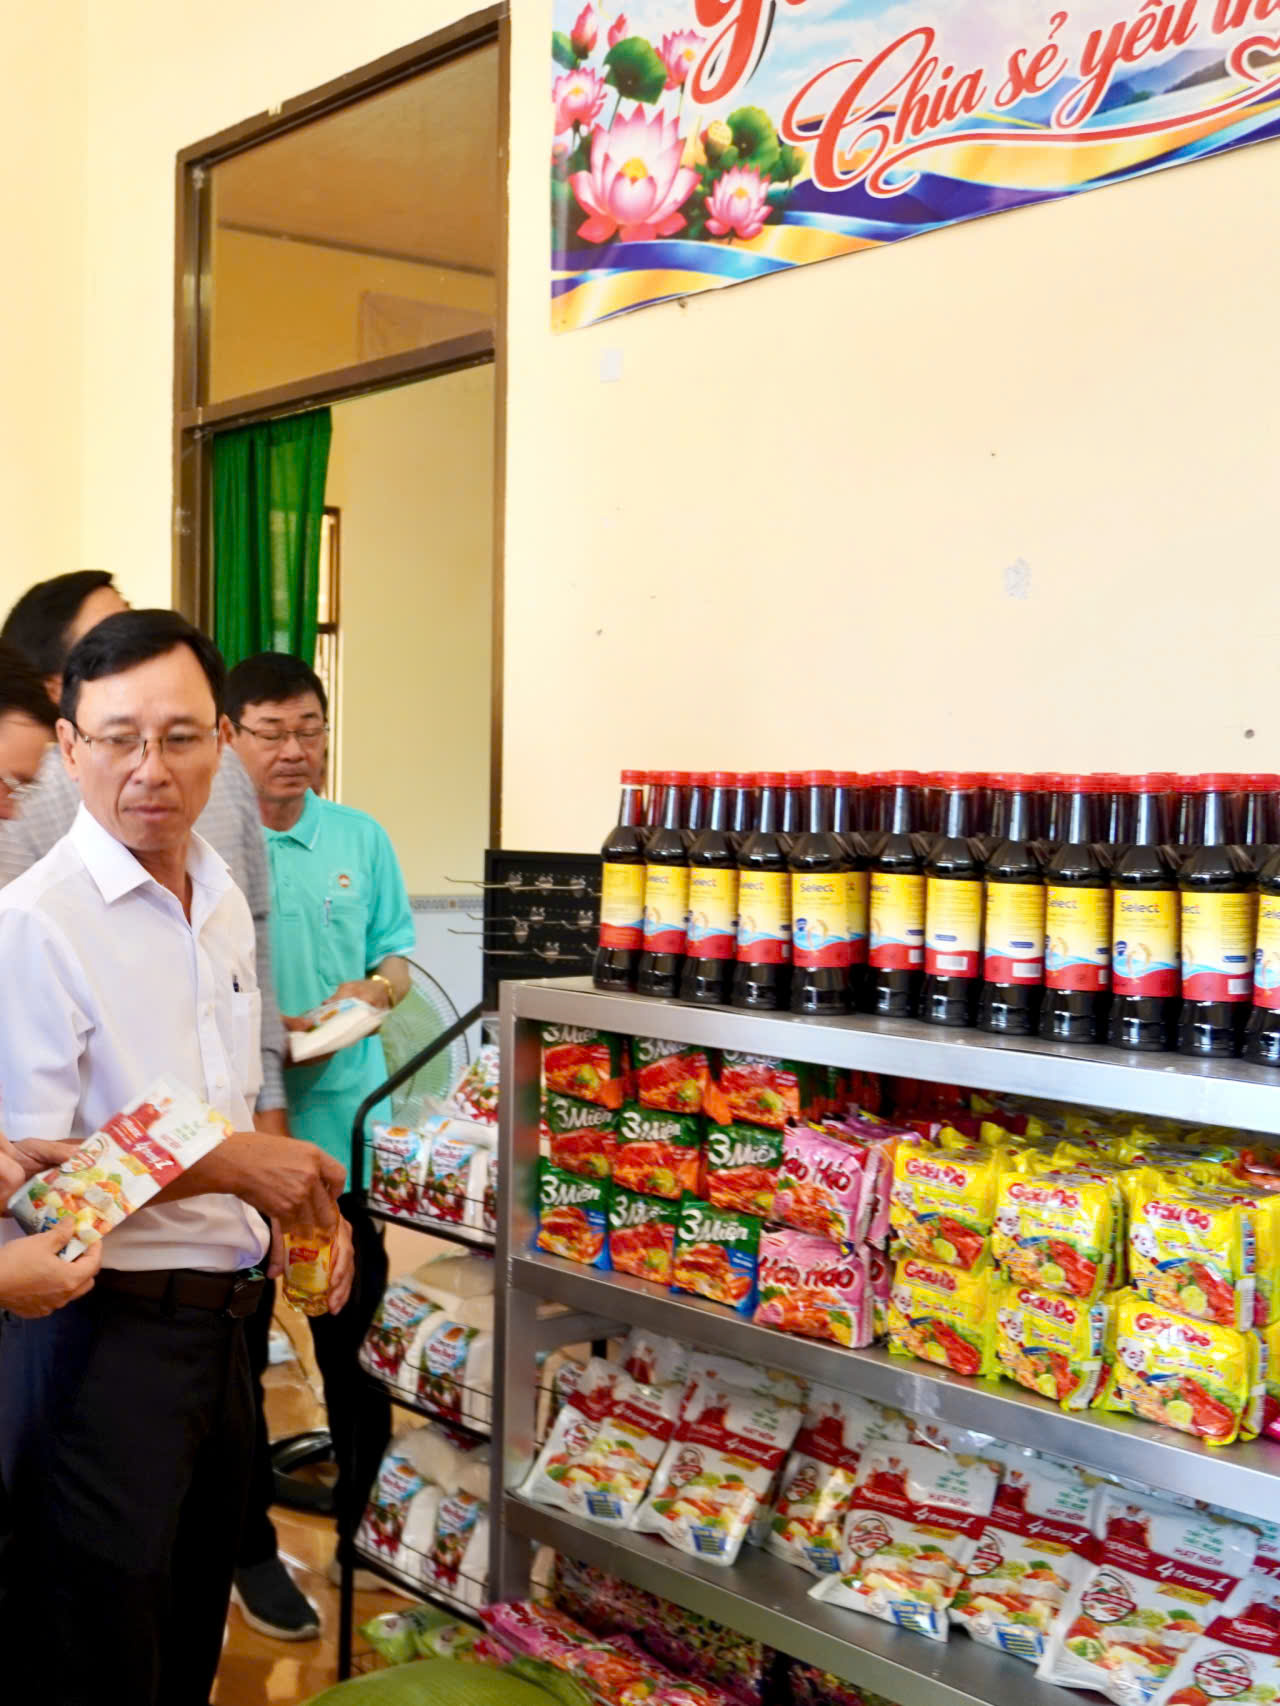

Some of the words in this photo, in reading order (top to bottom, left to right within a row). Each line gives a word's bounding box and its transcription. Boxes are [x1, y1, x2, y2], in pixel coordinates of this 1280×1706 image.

[783, 26, 985, 190] Chia
[996, 11, 1067, 105] sẻ
[1120, 901, 1160, 914] Select
